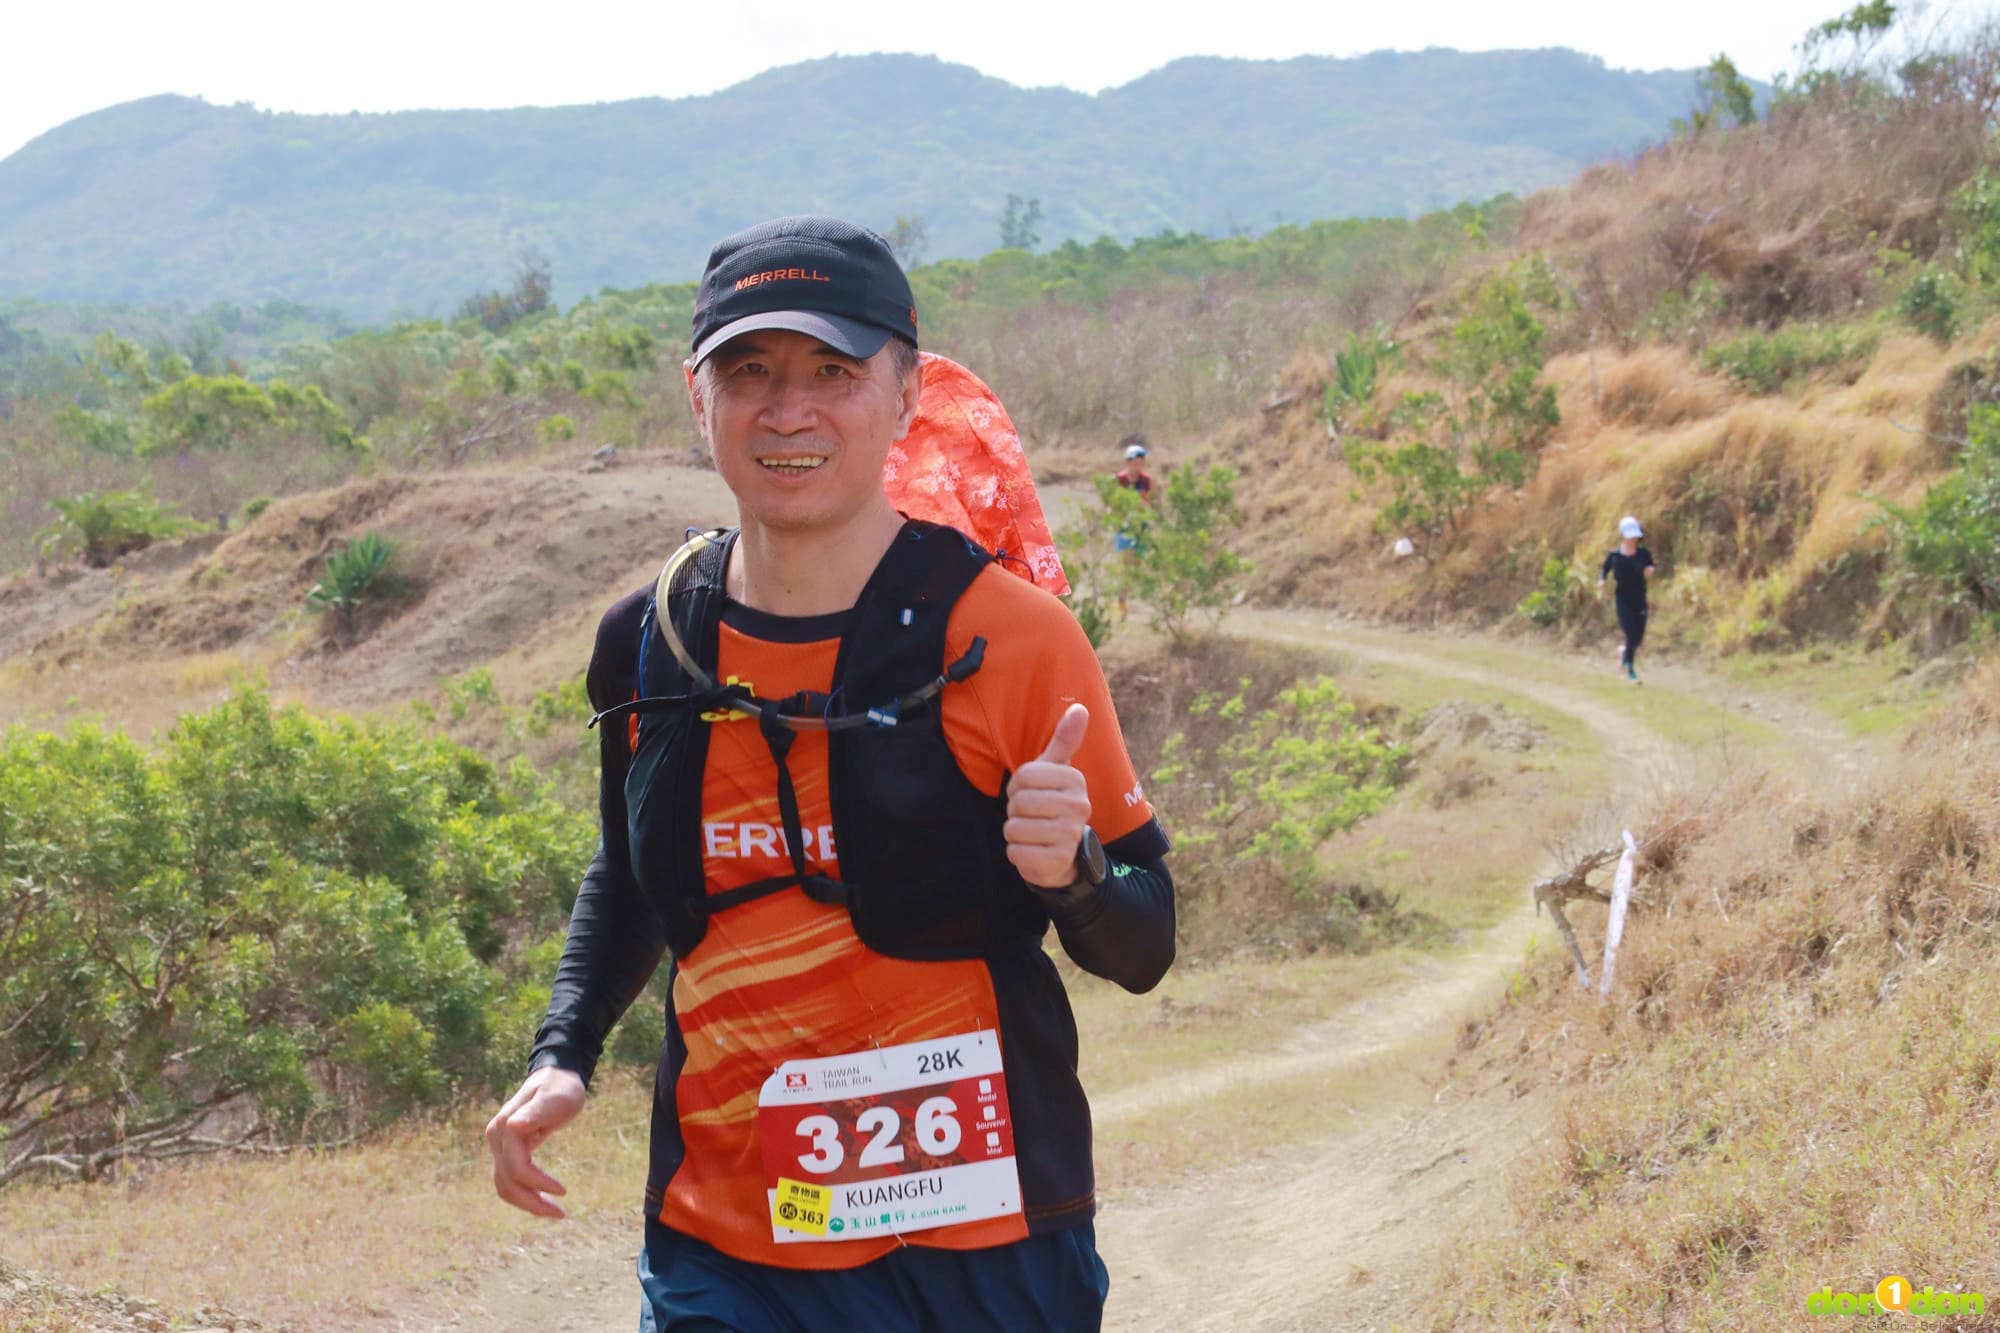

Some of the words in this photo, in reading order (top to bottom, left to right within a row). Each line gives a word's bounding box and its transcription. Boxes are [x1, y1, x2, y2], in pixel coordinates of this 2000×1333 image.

[735, 268, 825, 291] MERRELL
[917, 1048, 965, 1075] 28K
[823, 1066, 860, 1079] TAIWAN
[824, 1078, 849, 1089] TRAIL
[852, 1075, 872, 1087] RUN
[975, 1118, 1006, 1131] Souvenir
[795, 1096, 962, 1175] 326
[846, 1176, 943, 1208] KUANGFU
[799, 1209, 824, 1225] 363
[942, 1203, 967, 1215] BANK
